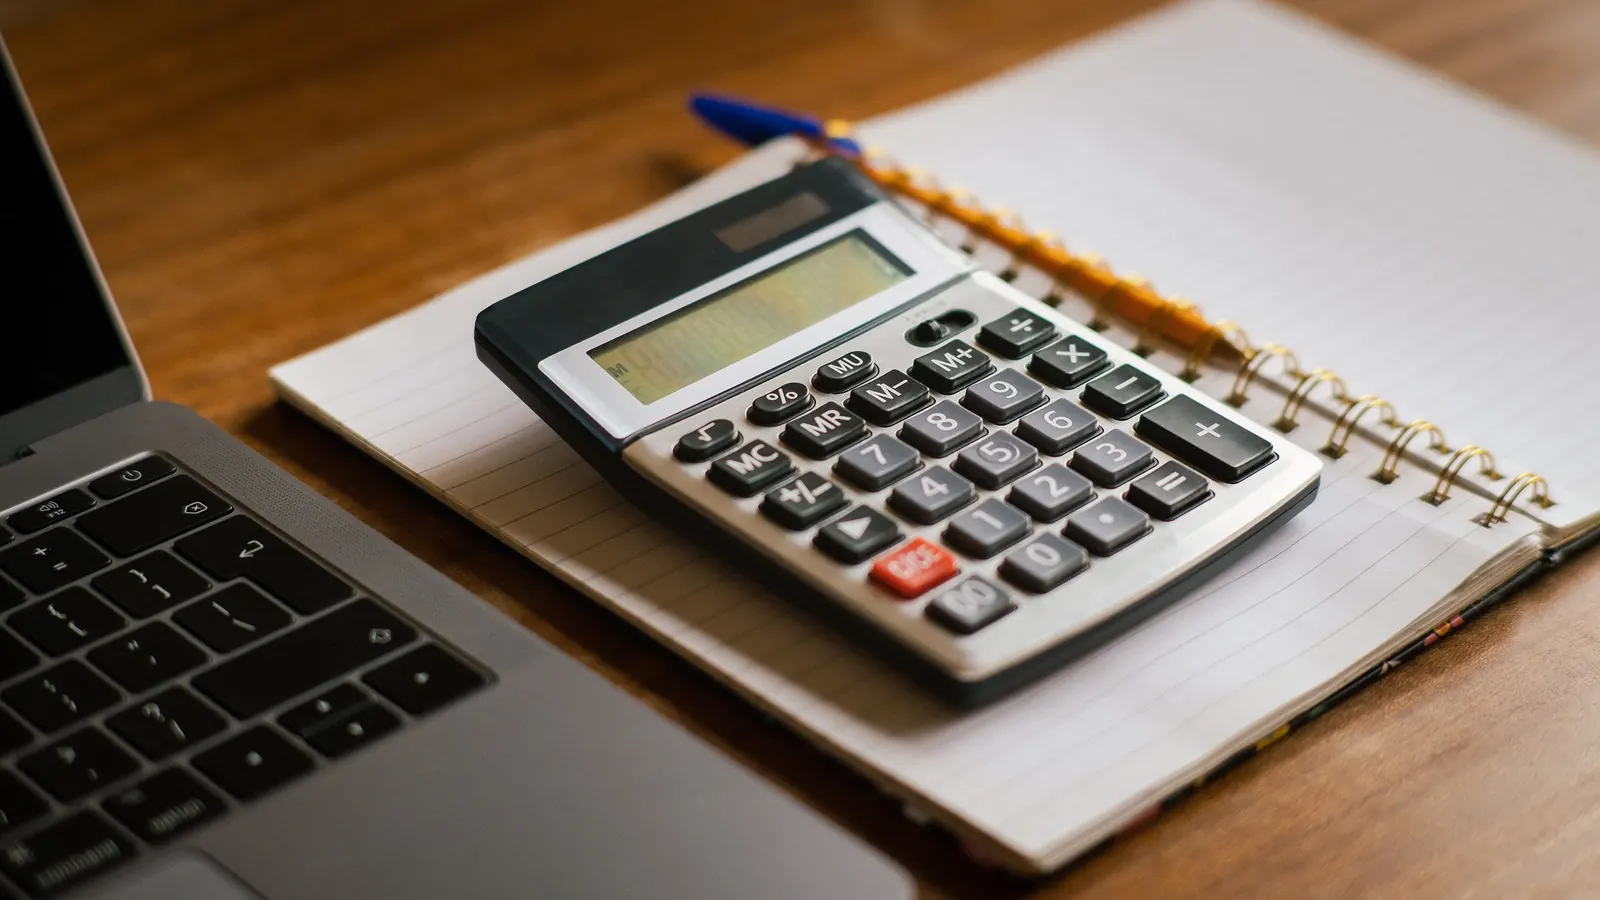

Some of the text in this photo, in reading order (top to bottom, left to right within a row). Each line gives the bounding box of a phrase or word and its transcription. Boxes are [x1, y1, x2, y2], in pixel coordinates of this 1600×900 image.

[827, 353, 864, 375] MU
[931, 347, 973, 371] M+
[766, 390, 799, 405] %
[989, 380, 1018, 399] 9
[799, 408, 852, 438] MR
[926, 412, 958, 431] 8
[1043, 410, 1073, 430] 6
[1195, 422, 1221, 438] +
[725, 443, 779, 476] MC
[859, 443, 887, 465] 7
[985, 441, 1014, 463] 5
[1095, 442, 1128, 463] 3
[920, 475, 950, 497] 4
[1033, 475, 1070, 499] 2
[971, 508, 1005, 532] 1
[1026, 542, 1062, 567] 0
